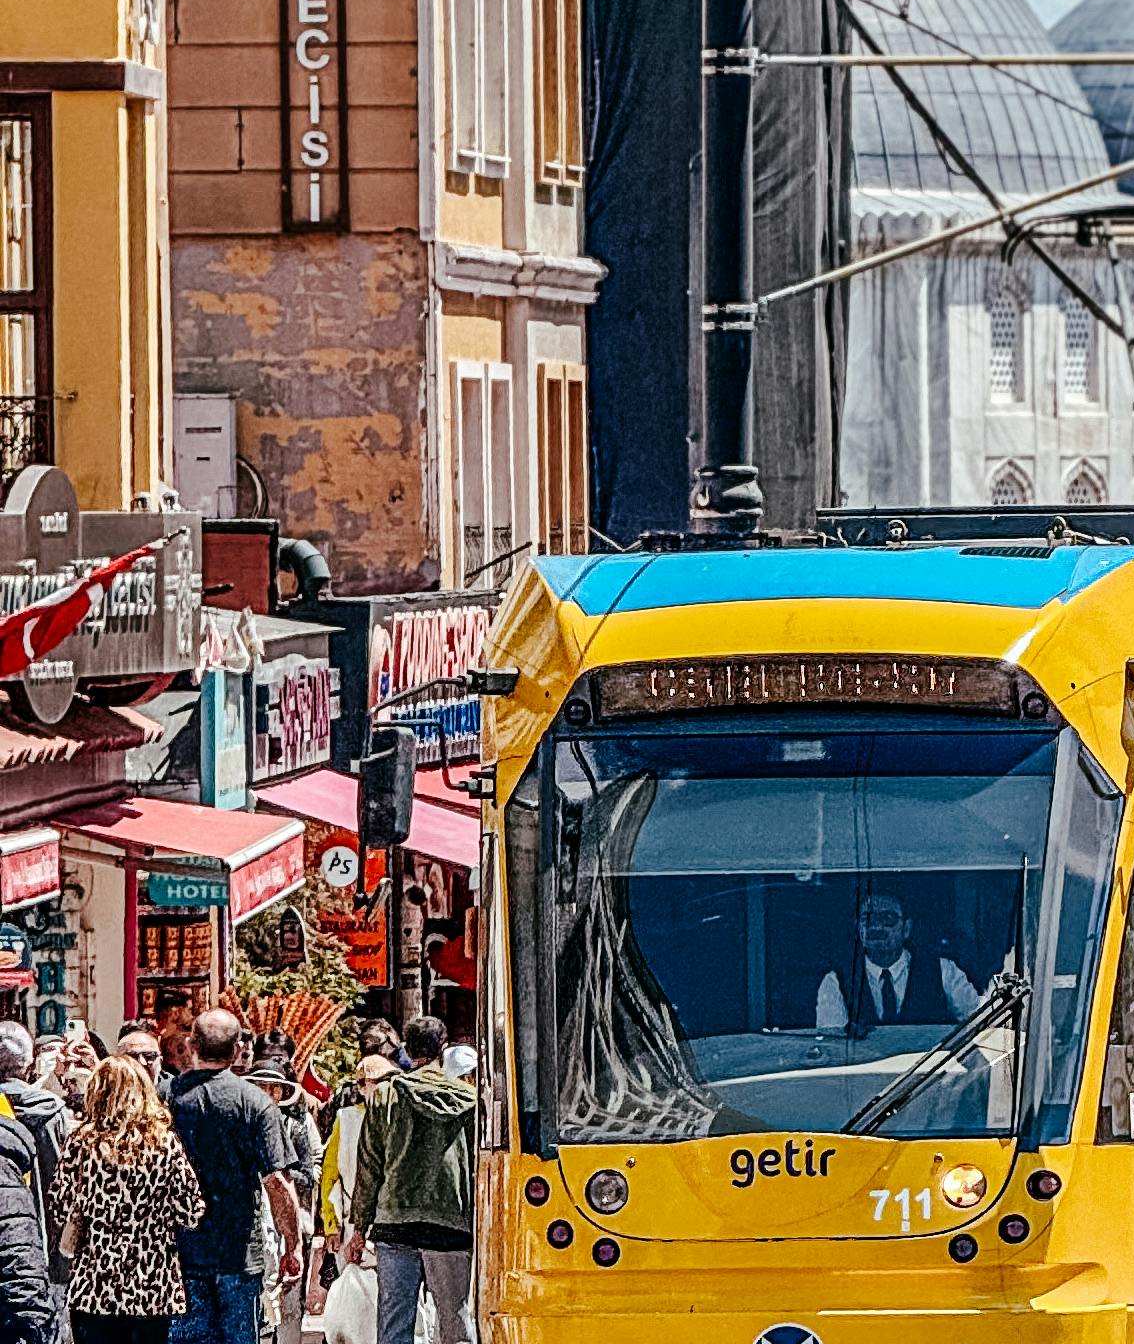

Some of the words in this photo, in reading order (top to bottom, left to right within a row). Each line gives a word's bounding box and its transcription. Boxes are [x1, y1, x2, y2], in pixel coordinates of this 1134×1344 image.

[167, 884, 228, 899] HOTEL
[729, 1139, 837, 1188] getir
[869, 1188, 932, 1221] 711
